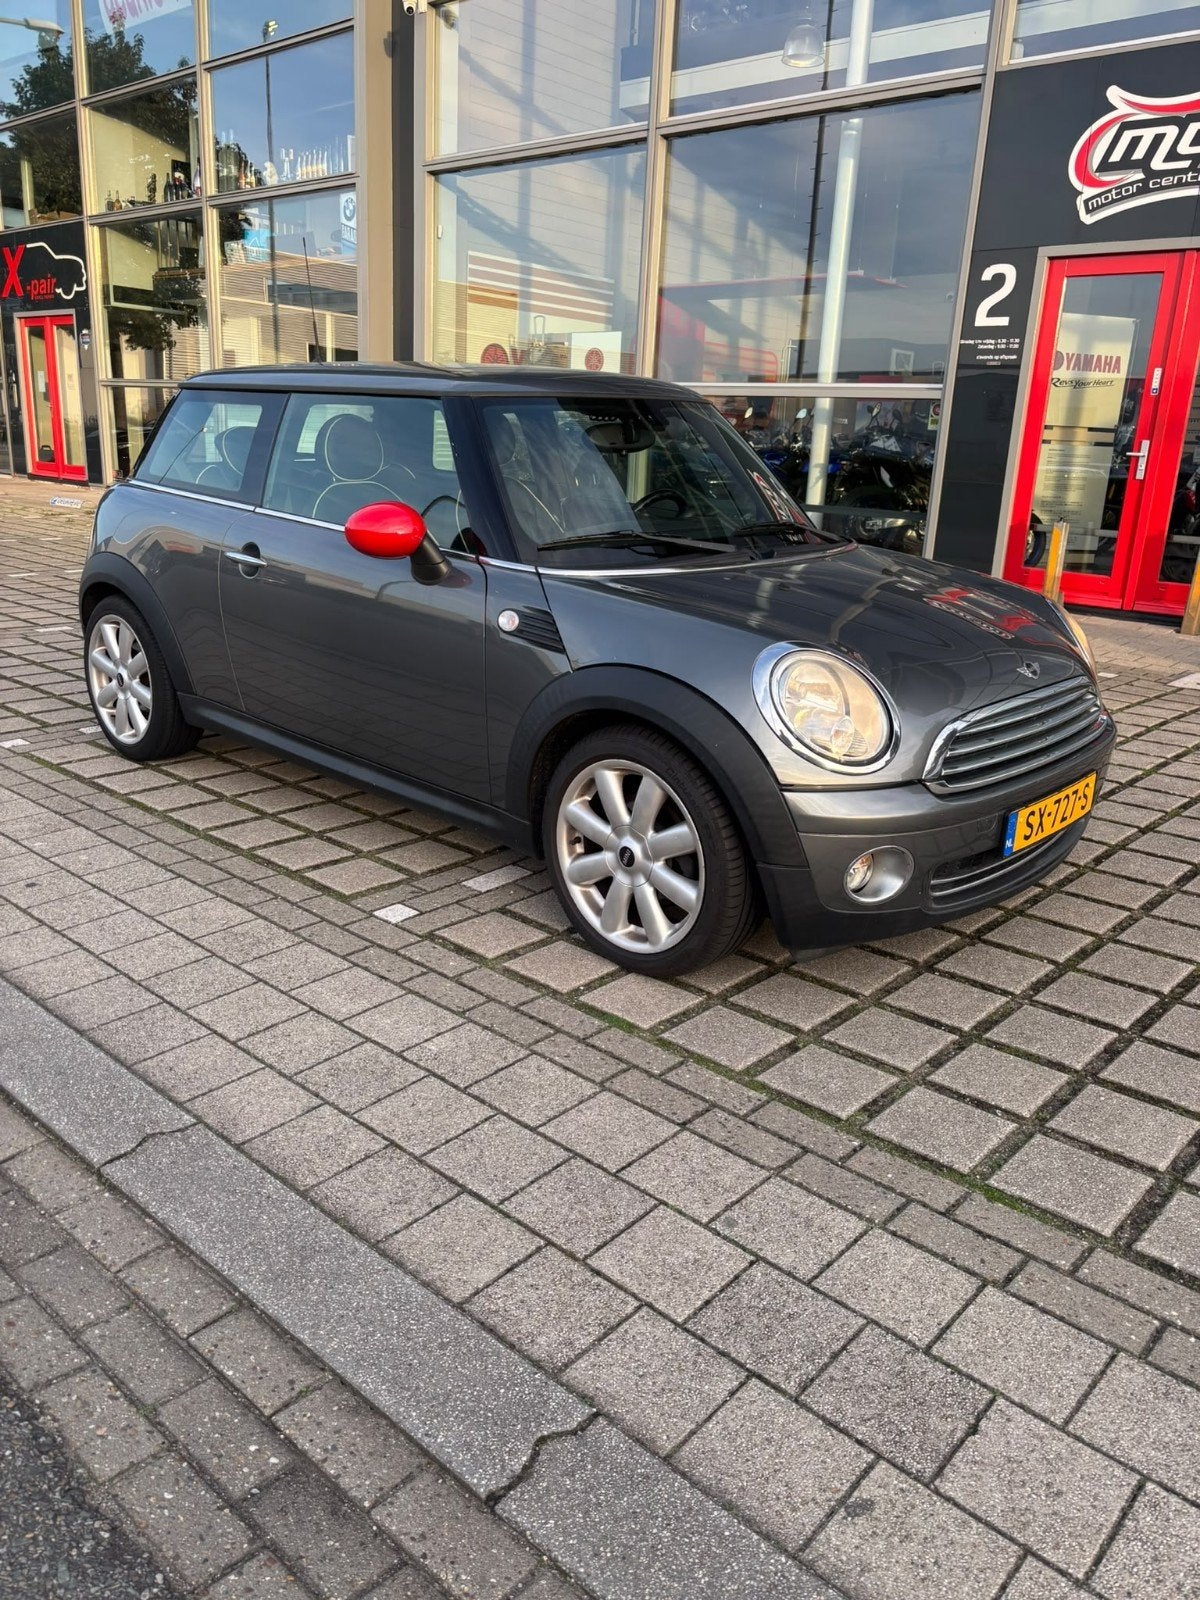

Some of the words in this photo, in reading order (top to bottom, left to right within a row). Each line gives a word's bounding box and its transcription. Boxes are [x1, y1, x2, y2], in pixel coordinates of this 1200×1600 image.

[1088, 182, 1142, 210] motor
[1149, 172, 1200, 188] cent
[974, 263, 1017, 327] 2
[1065, 352, 1122, 374] YAMAHA
[1073, 380, 1092, 389] Your
[1092, 380, 1115, 388] Heart
[1023, 782, 1090, 841] SX-727-S
[1005, 838, 1013, 849] NL
